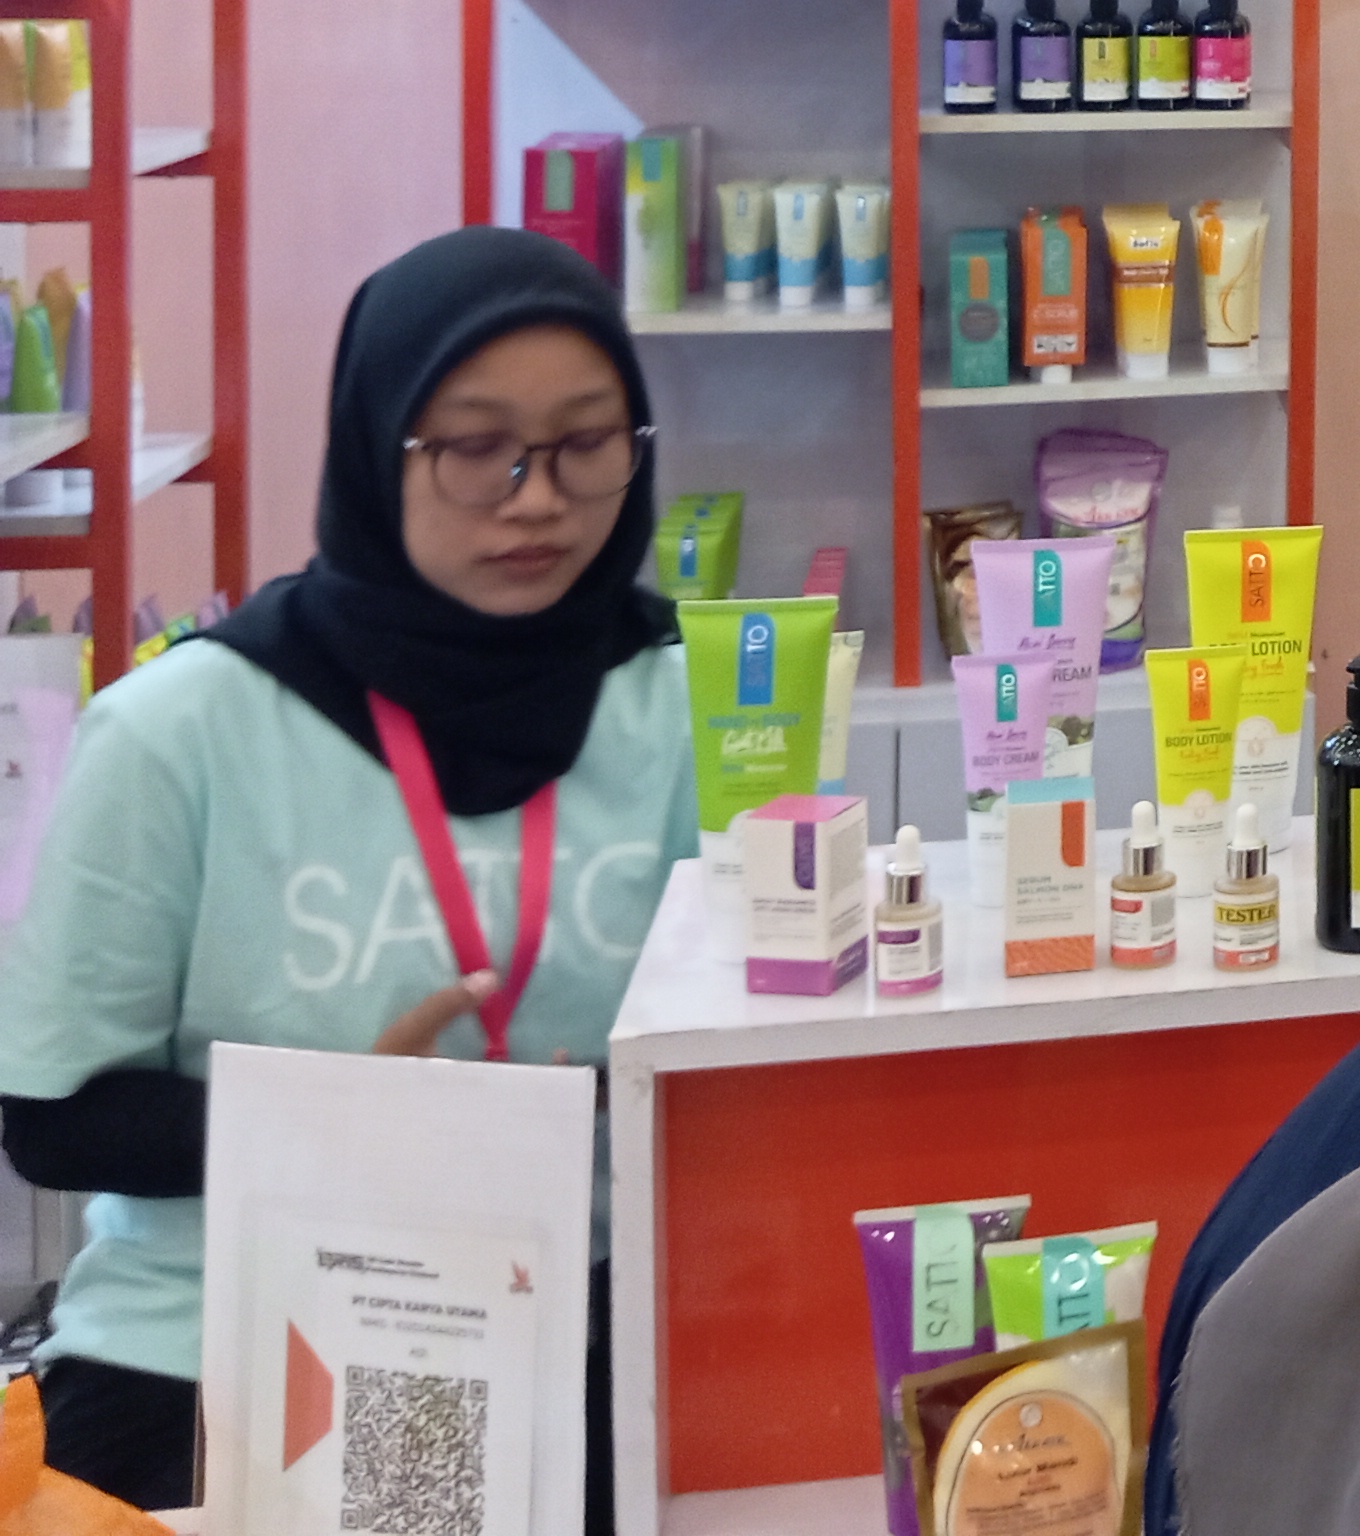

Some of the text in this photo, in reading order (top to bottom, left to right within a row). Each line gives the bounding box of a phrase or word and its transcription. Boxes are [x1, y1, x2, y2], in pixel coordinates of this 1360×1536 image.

[1038, 559, 1057, 601] ATTO
[1248, 553, 1266, 608] SATTO
[1251, 639, 1303, 657] LOTION
[1053, 667, 1093, 683] REAM
[1002, 672, 1016, 707] ATTO
[1165, 732, 1233, 748] BODY LOTION
